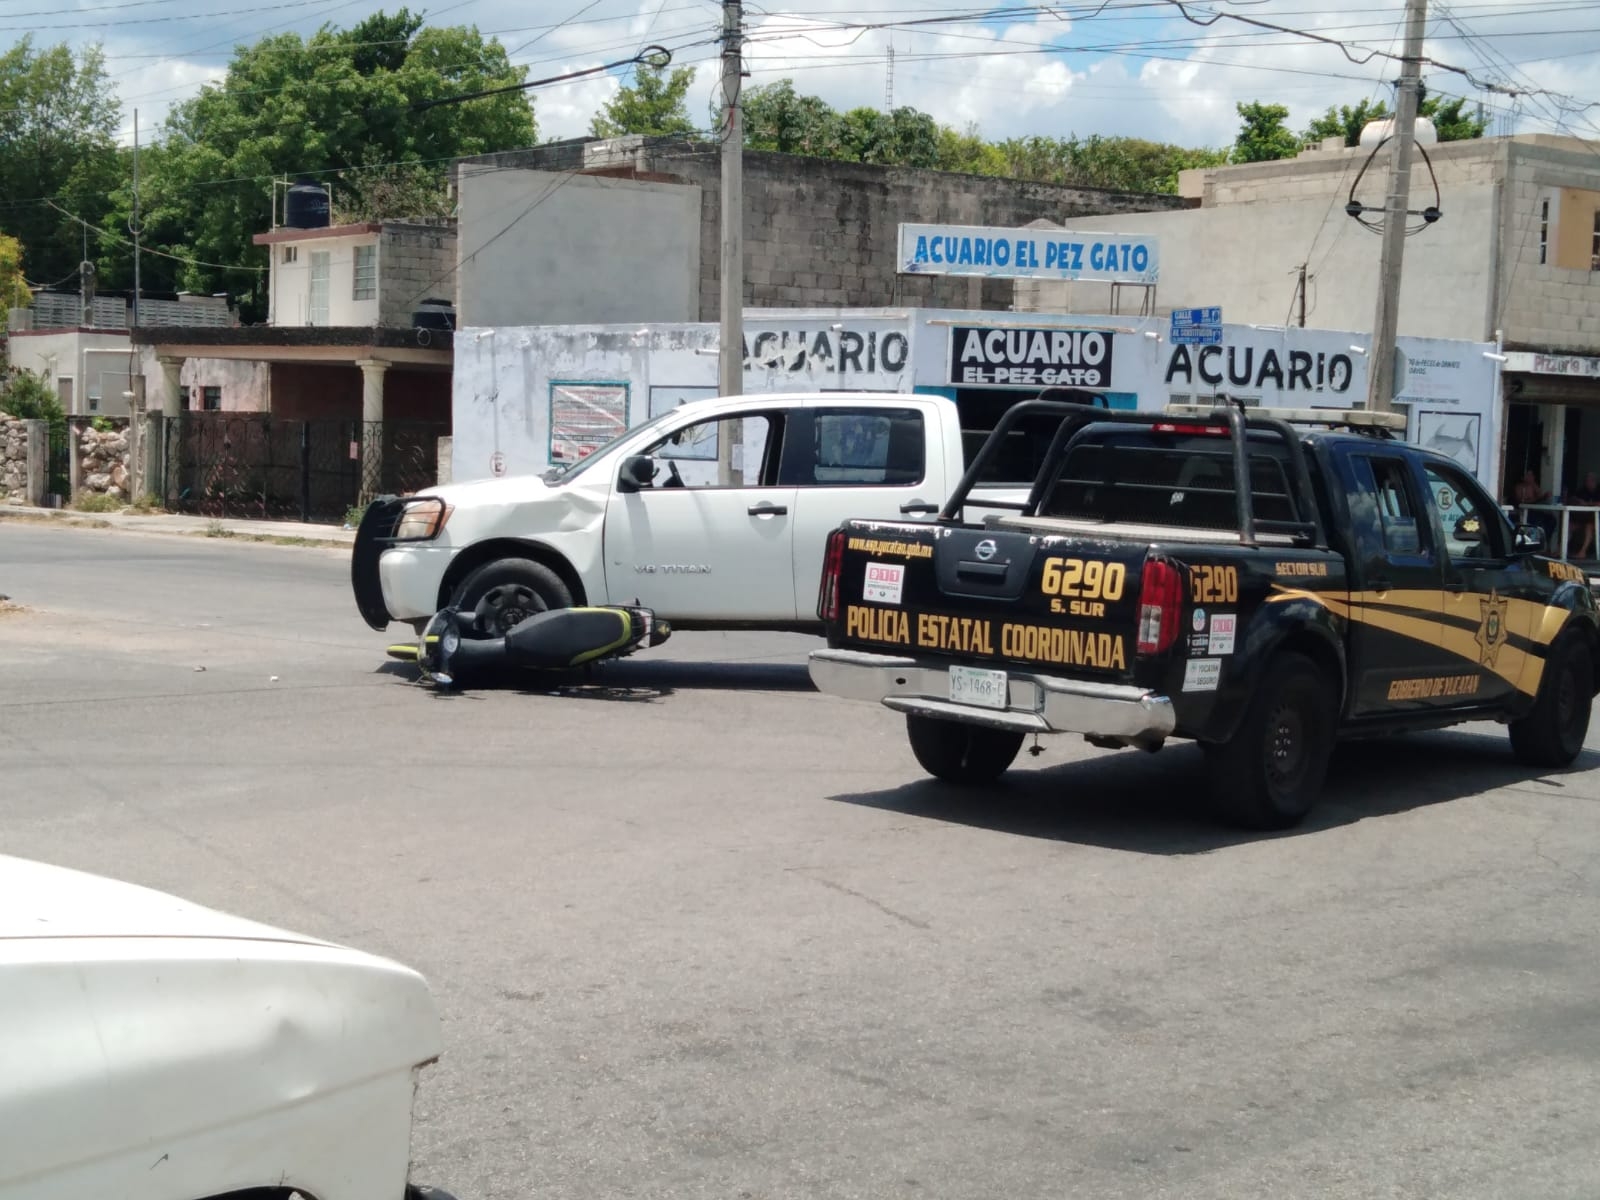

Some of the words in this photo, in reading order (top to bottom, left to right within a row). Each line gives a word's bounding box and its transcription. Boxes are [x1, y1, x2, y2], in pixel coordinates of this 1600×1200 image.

[914, 235, 1011, 267] ACUARIO
[1015, 240, 1039, 268] EL
[1045, 241, 1085, 271] PEZ
[1090, 243, 1148, 273] GATO
[960, 329, 1106, 366] ACUARIO
[963, 366, 989, 384] EL
[994, 367, 1036, 385] PEZ
[1041, 368, 1101, 386] GATO
[1164, 343, 1354, 392] ACUARIO
[633, 564, 657, 575] V8
[661, 564, 712, 575] TITAN
[868, 568, 900, 583] 911
[1041, 556, 1126, 602] 6290
[1190, 564, 1238, 603] 6290
[1050, 598, 1066, 613] S.
[1070, 600, 1105, 617] SUR
[847, 605, 910, 644] POLICIA
[917, 613, 994, 655] ESTATAL
[1001, 622, 1126, 670] COORDINADA
